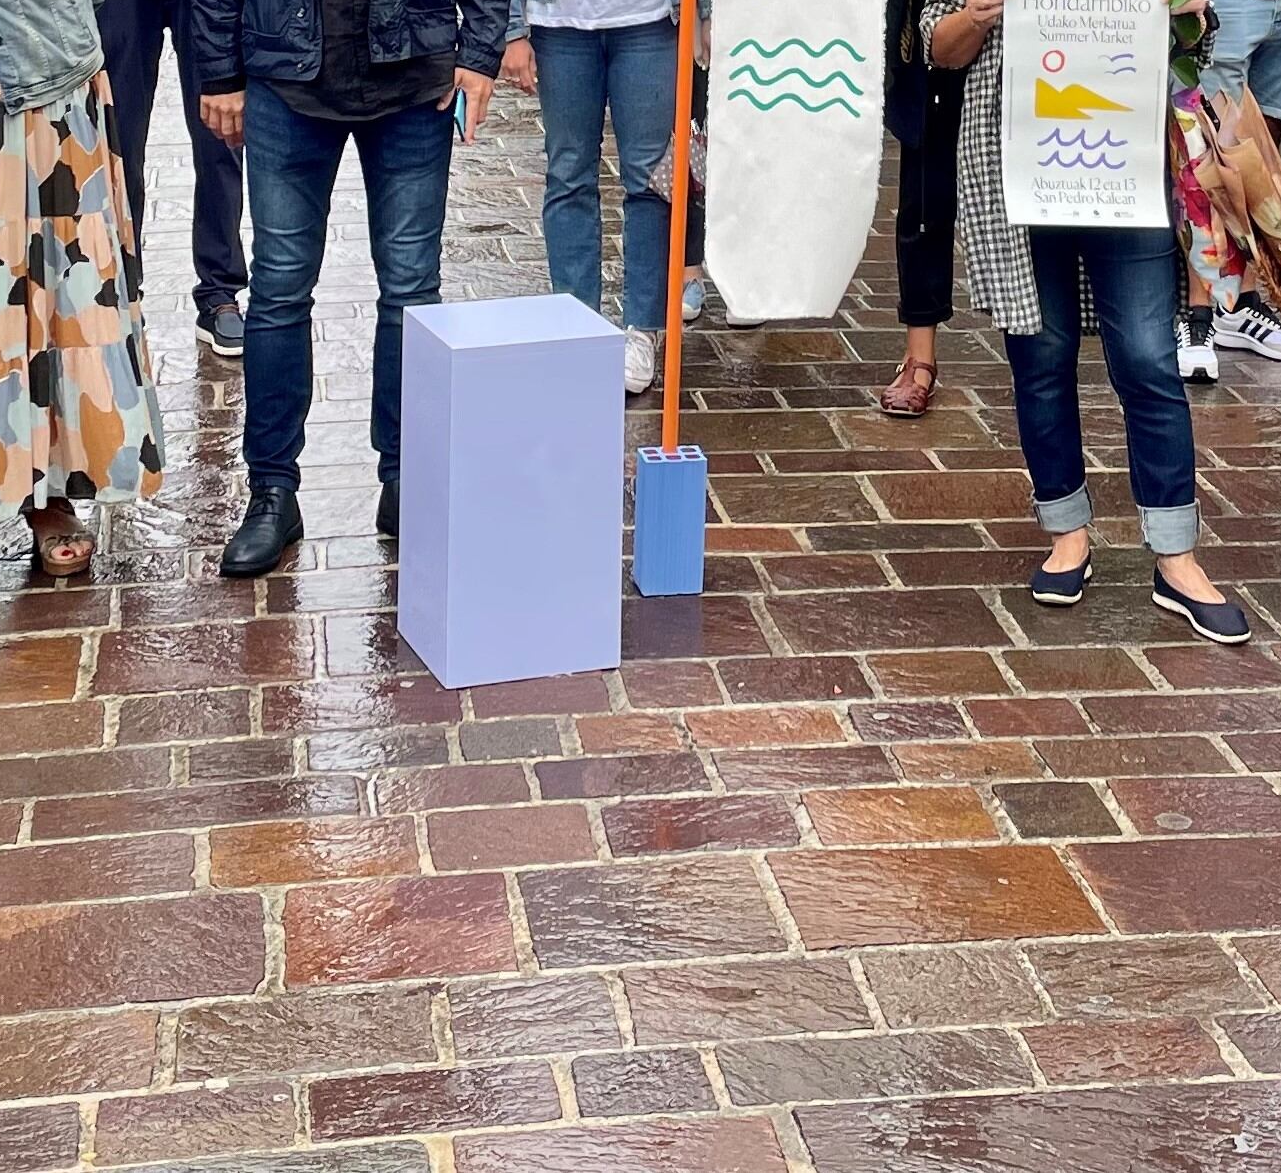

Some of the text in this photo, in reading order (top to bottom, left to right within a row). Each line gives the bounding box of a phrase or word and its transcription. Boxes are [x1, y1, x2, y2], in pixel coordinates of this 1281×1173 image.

[1038, 15, 1136, 30] Udako Merkatua
[1039, 29, 1133, 44] Summer Market
[1032, 177, 1086, 191] Abuztuak
[1089, 178, 1100, 191] 12
[1103, 180, 1121, 191] eta
[1033, 191, 1135, 205] San Pedro Kalean
